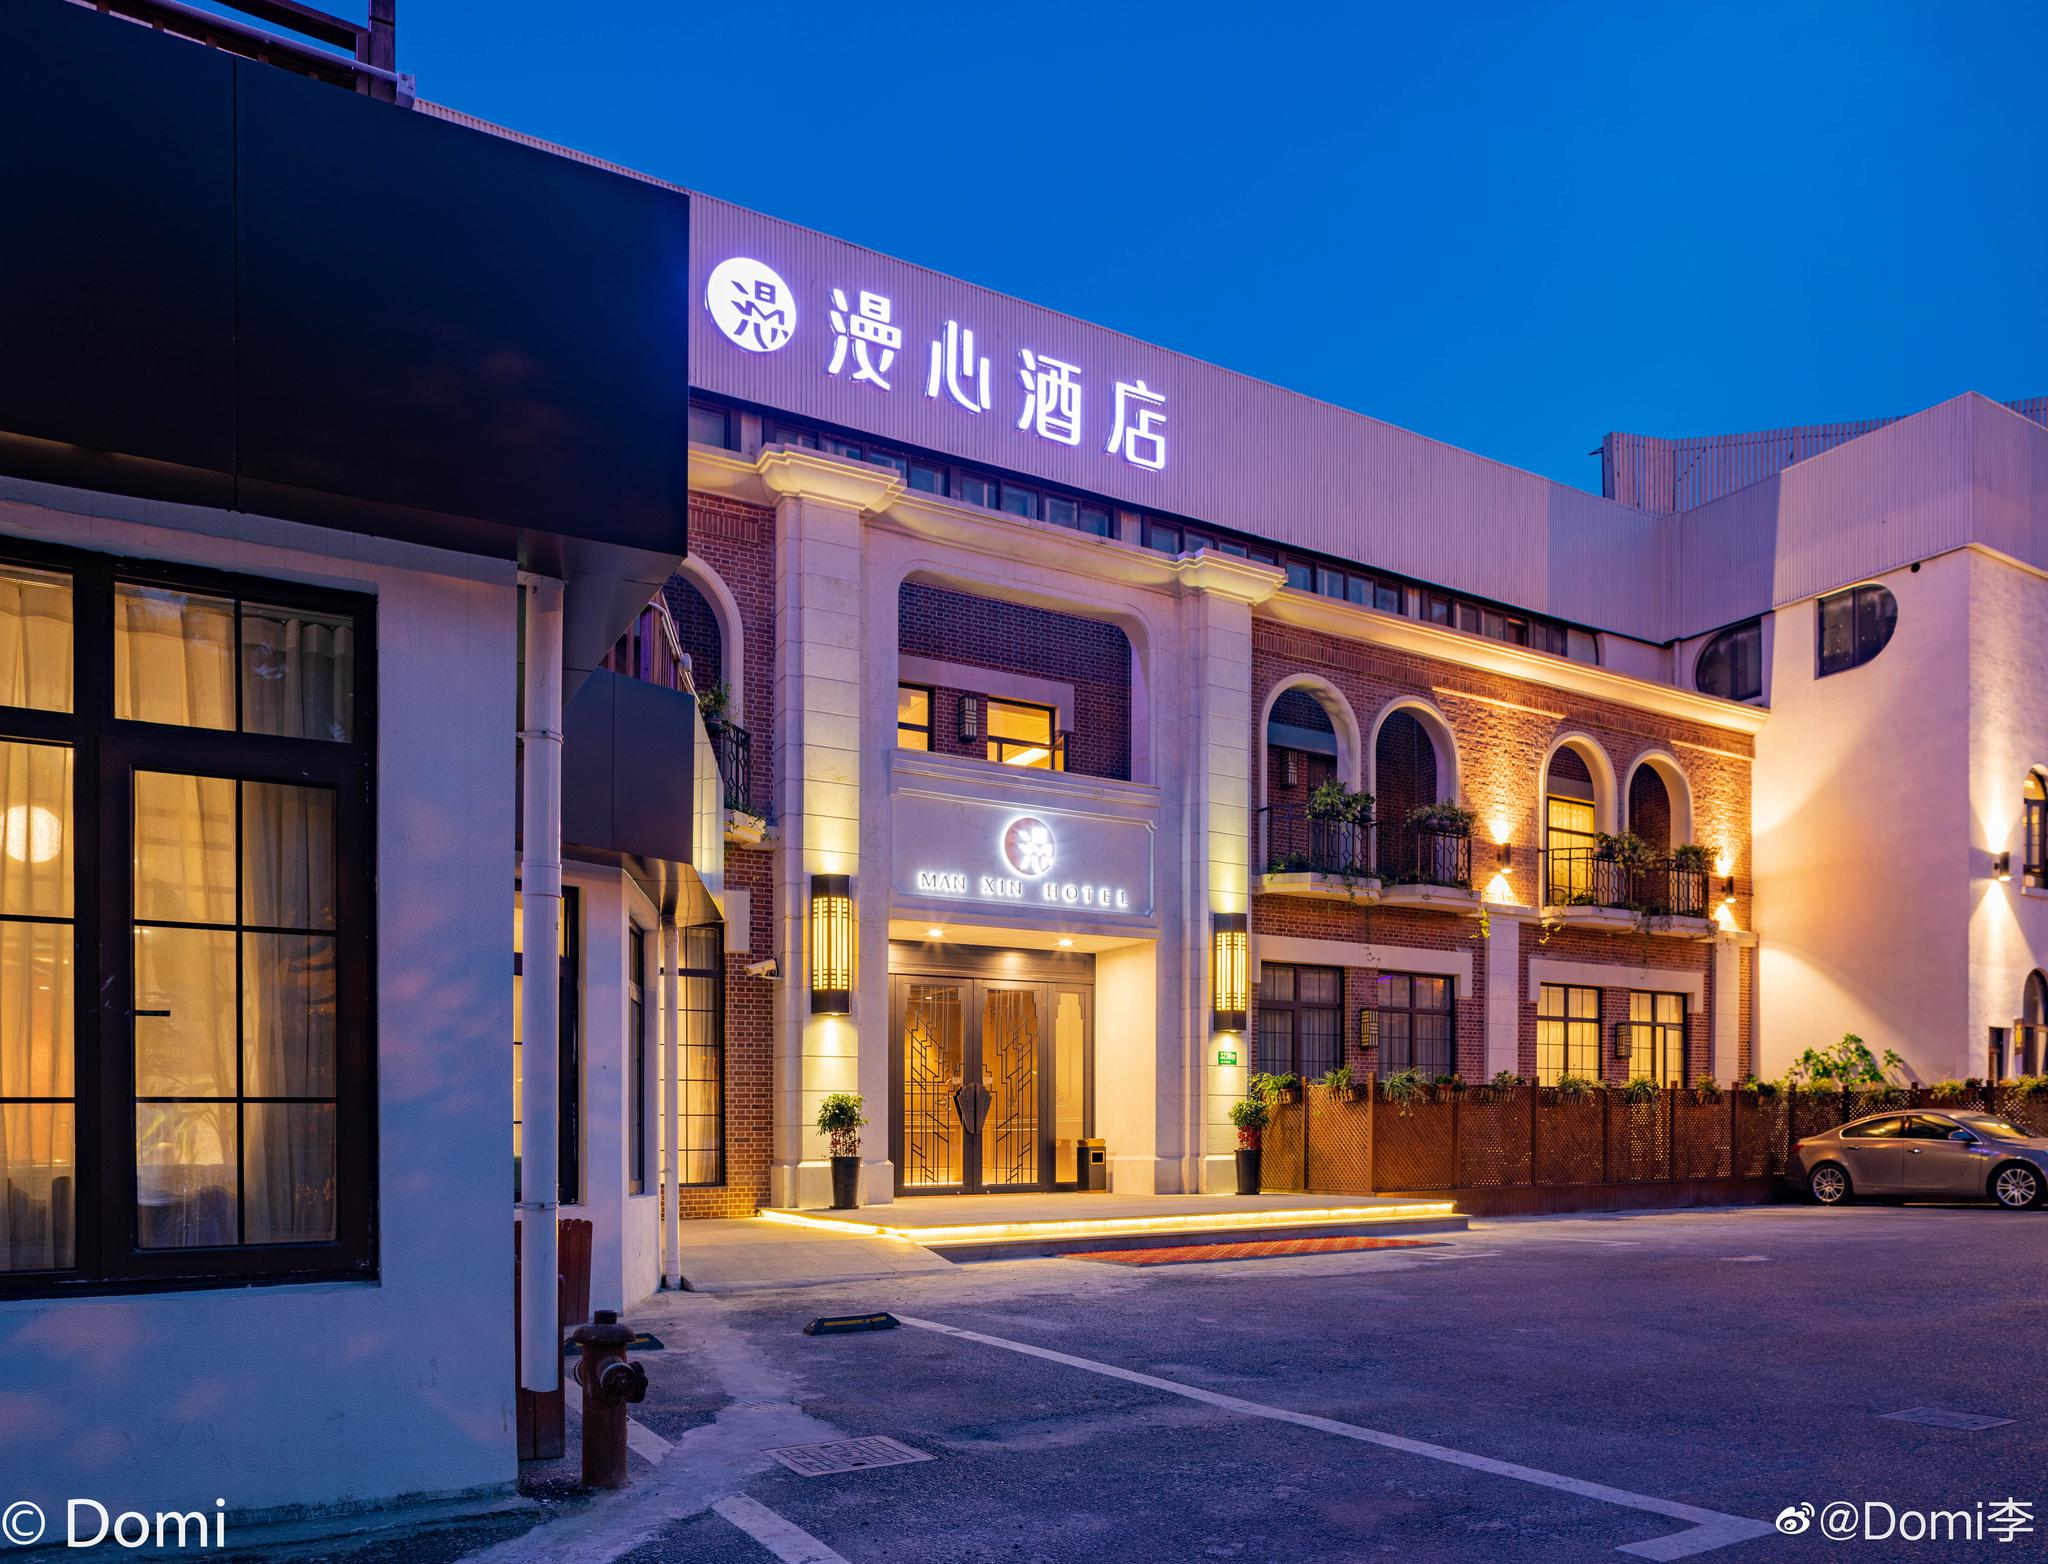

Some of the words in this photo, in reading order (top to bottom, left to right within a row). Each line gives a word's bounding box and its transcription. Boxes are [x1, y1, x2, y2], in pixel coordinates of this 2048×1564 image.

[826, 287, 1167, 471] 漫心酒店
[920, 872, 966, 891] MAN
[983, 877, 1022, 895] XIN
[1045, 883, 1129, 905] HOTEL
